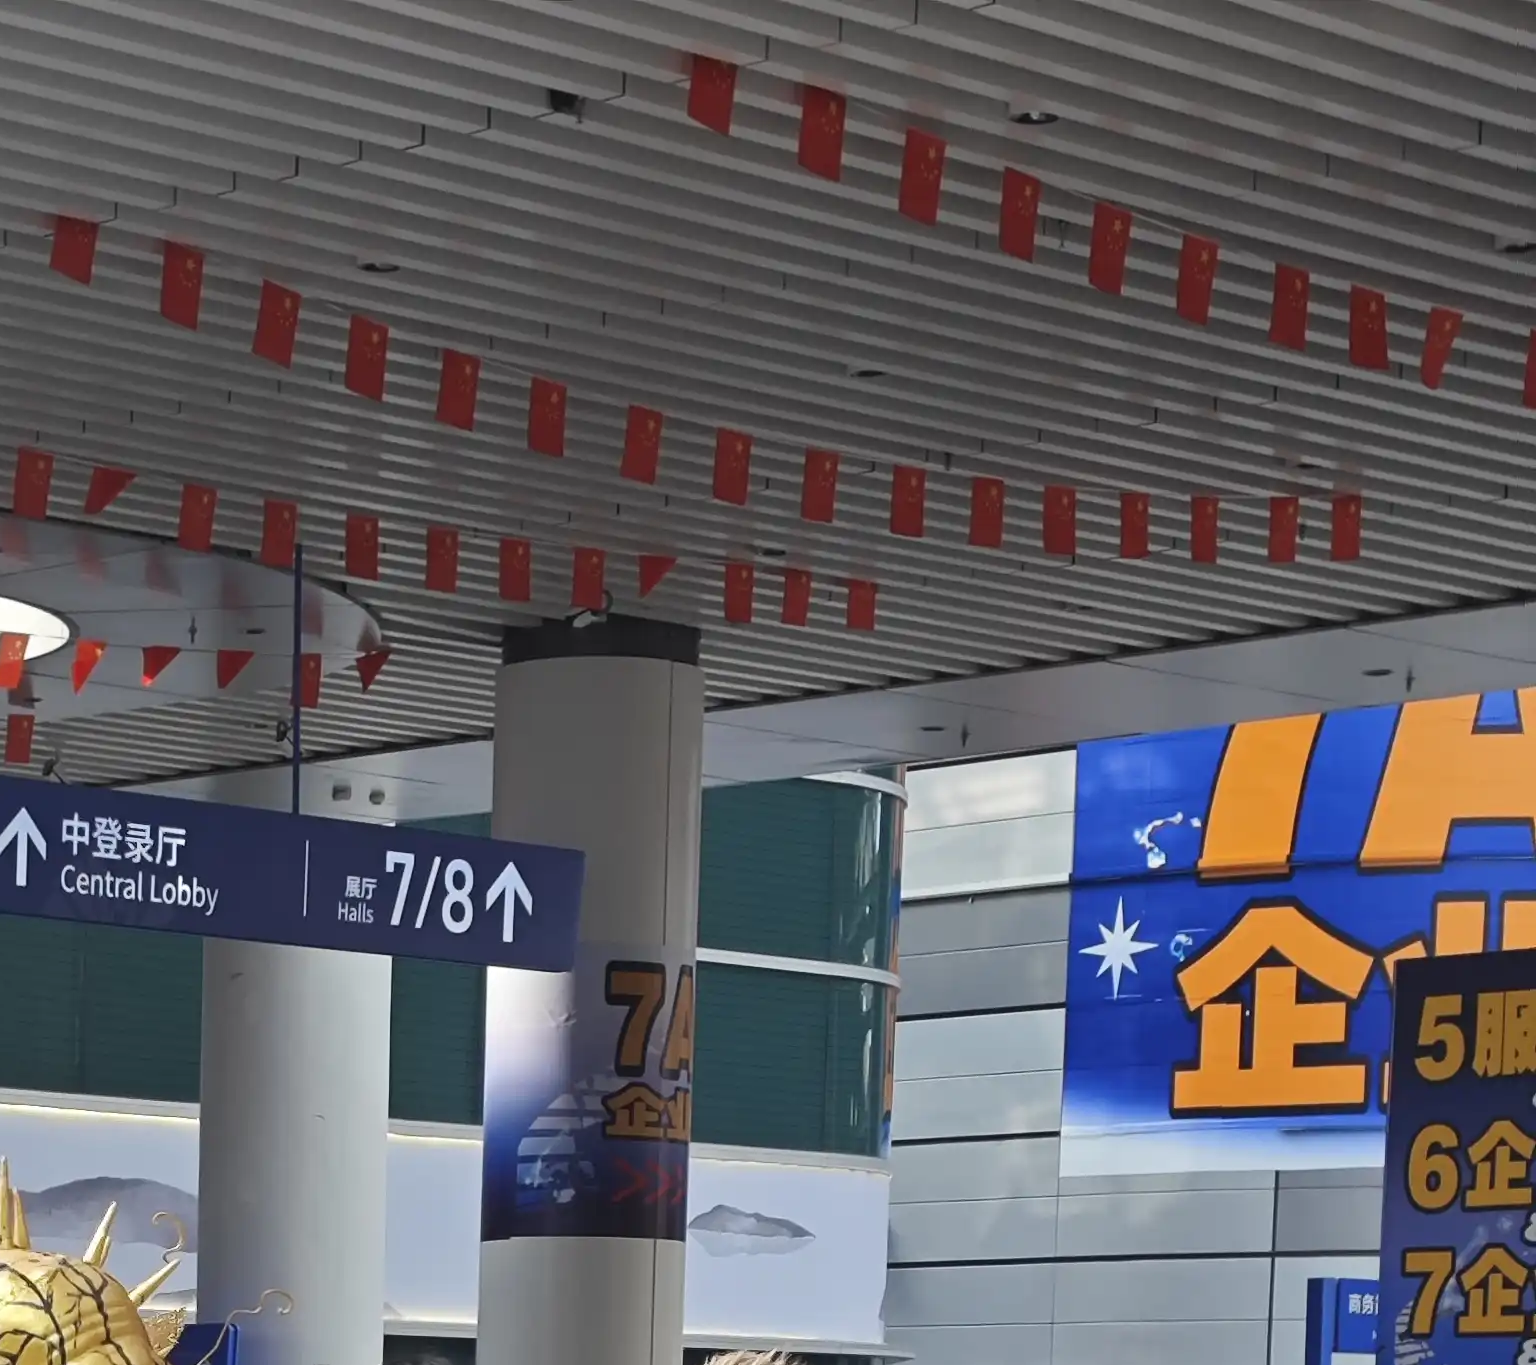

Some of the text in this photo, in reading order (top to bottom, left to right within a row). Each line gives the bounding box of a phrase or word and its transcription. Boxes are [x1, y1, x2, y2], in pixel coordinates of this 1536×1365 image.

[61, 812, 187, 867] 中登录厅
[61, 864, 219, 916] Central Lobby
[337, 901, 374, 924] Halls
[345, 875, 377, 900] 展厅
[385, 850, 474, 934] 7/8
